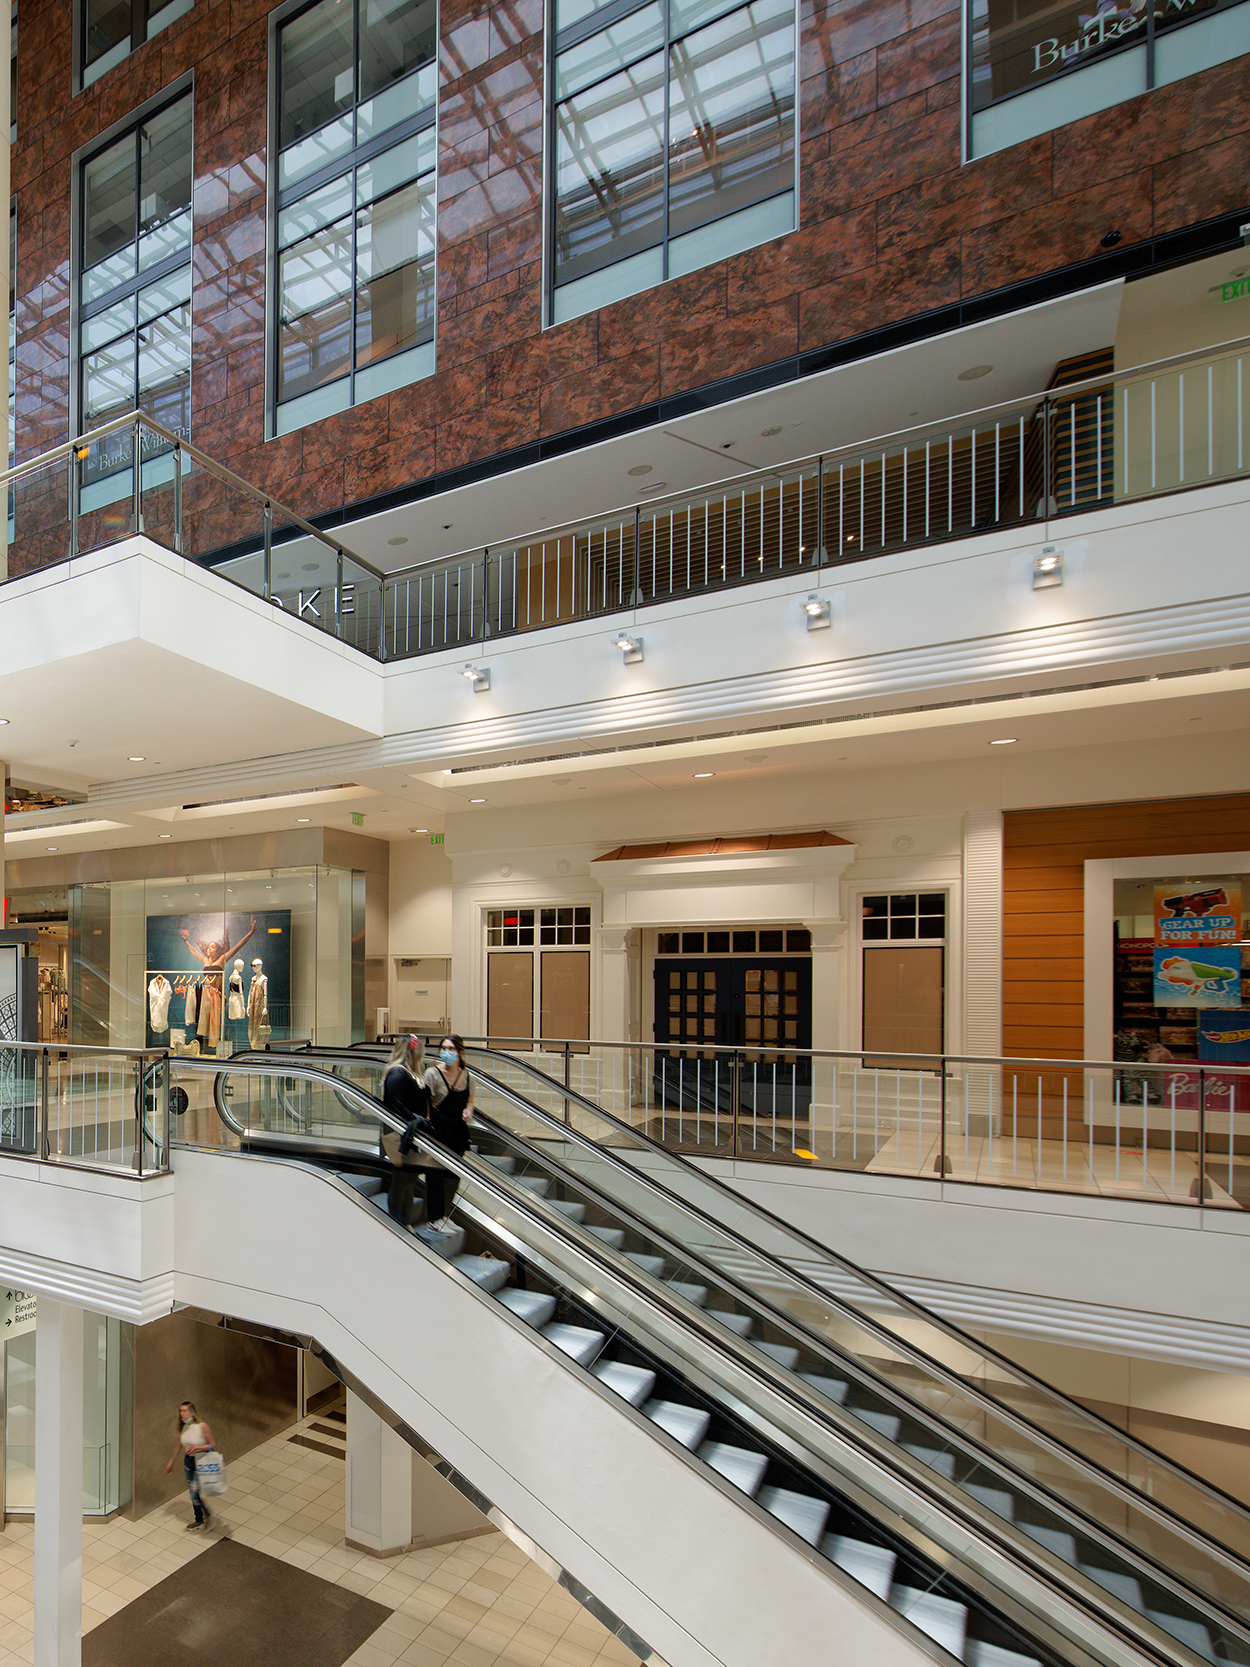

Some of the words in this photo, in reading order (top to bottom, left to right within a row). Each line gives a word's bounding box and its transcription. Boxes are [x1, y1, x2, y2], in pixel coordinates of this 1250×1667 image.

[1030, 14, 1138, 74] Burke
[1222, 279, 1250, 301] EXIT
[98, 443, 132, 471] Burke
[430, 834, 444, 845] EXIT
[1163, 919, 1205, 930] GEAR
[1209, 917, 1231, 927] UP
[1160, 931, 1193, 940] FOR
[1196, 930, 1237, 940] FUN!
